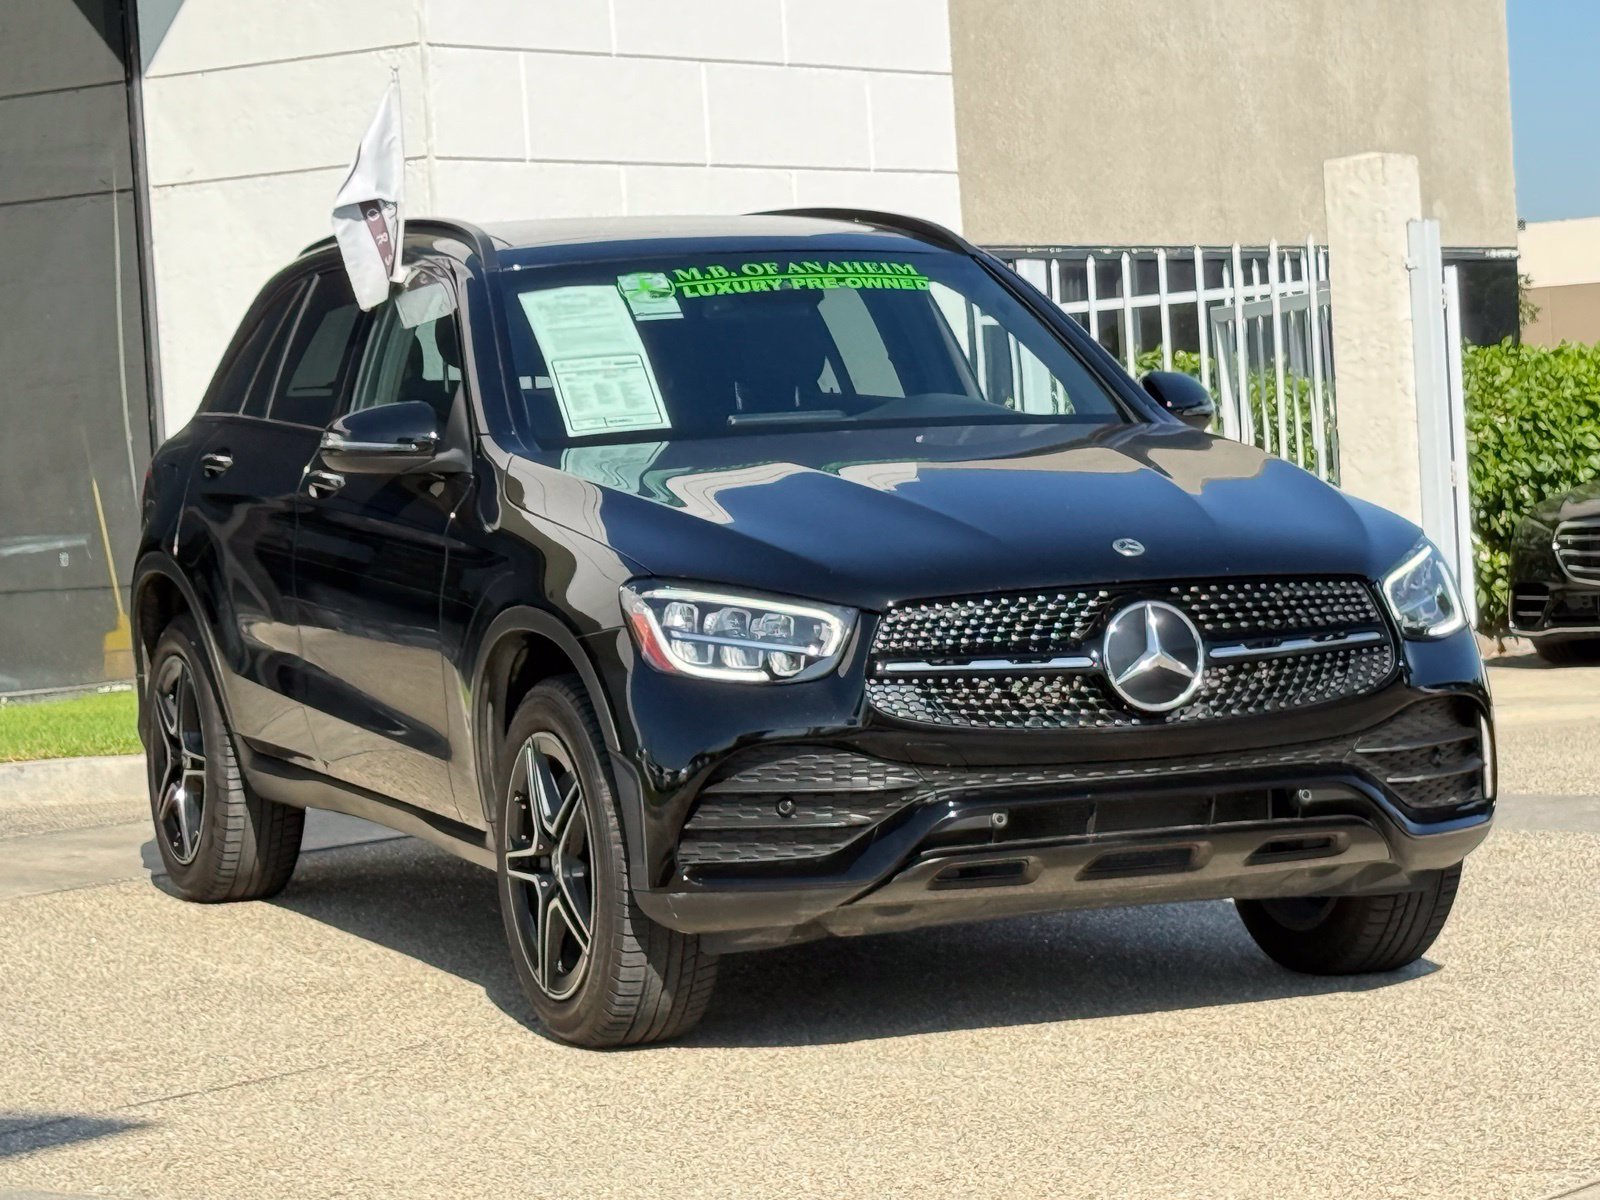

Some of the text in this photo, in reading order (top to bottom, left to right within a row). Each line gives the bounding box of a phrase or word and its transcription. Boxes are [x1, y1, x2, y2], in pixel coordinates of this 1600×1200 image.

[671, 261, 919, 282] M.B. OF ANAHEIM
[682, 277, 928, 299] LUXURY PRE-OWNED
